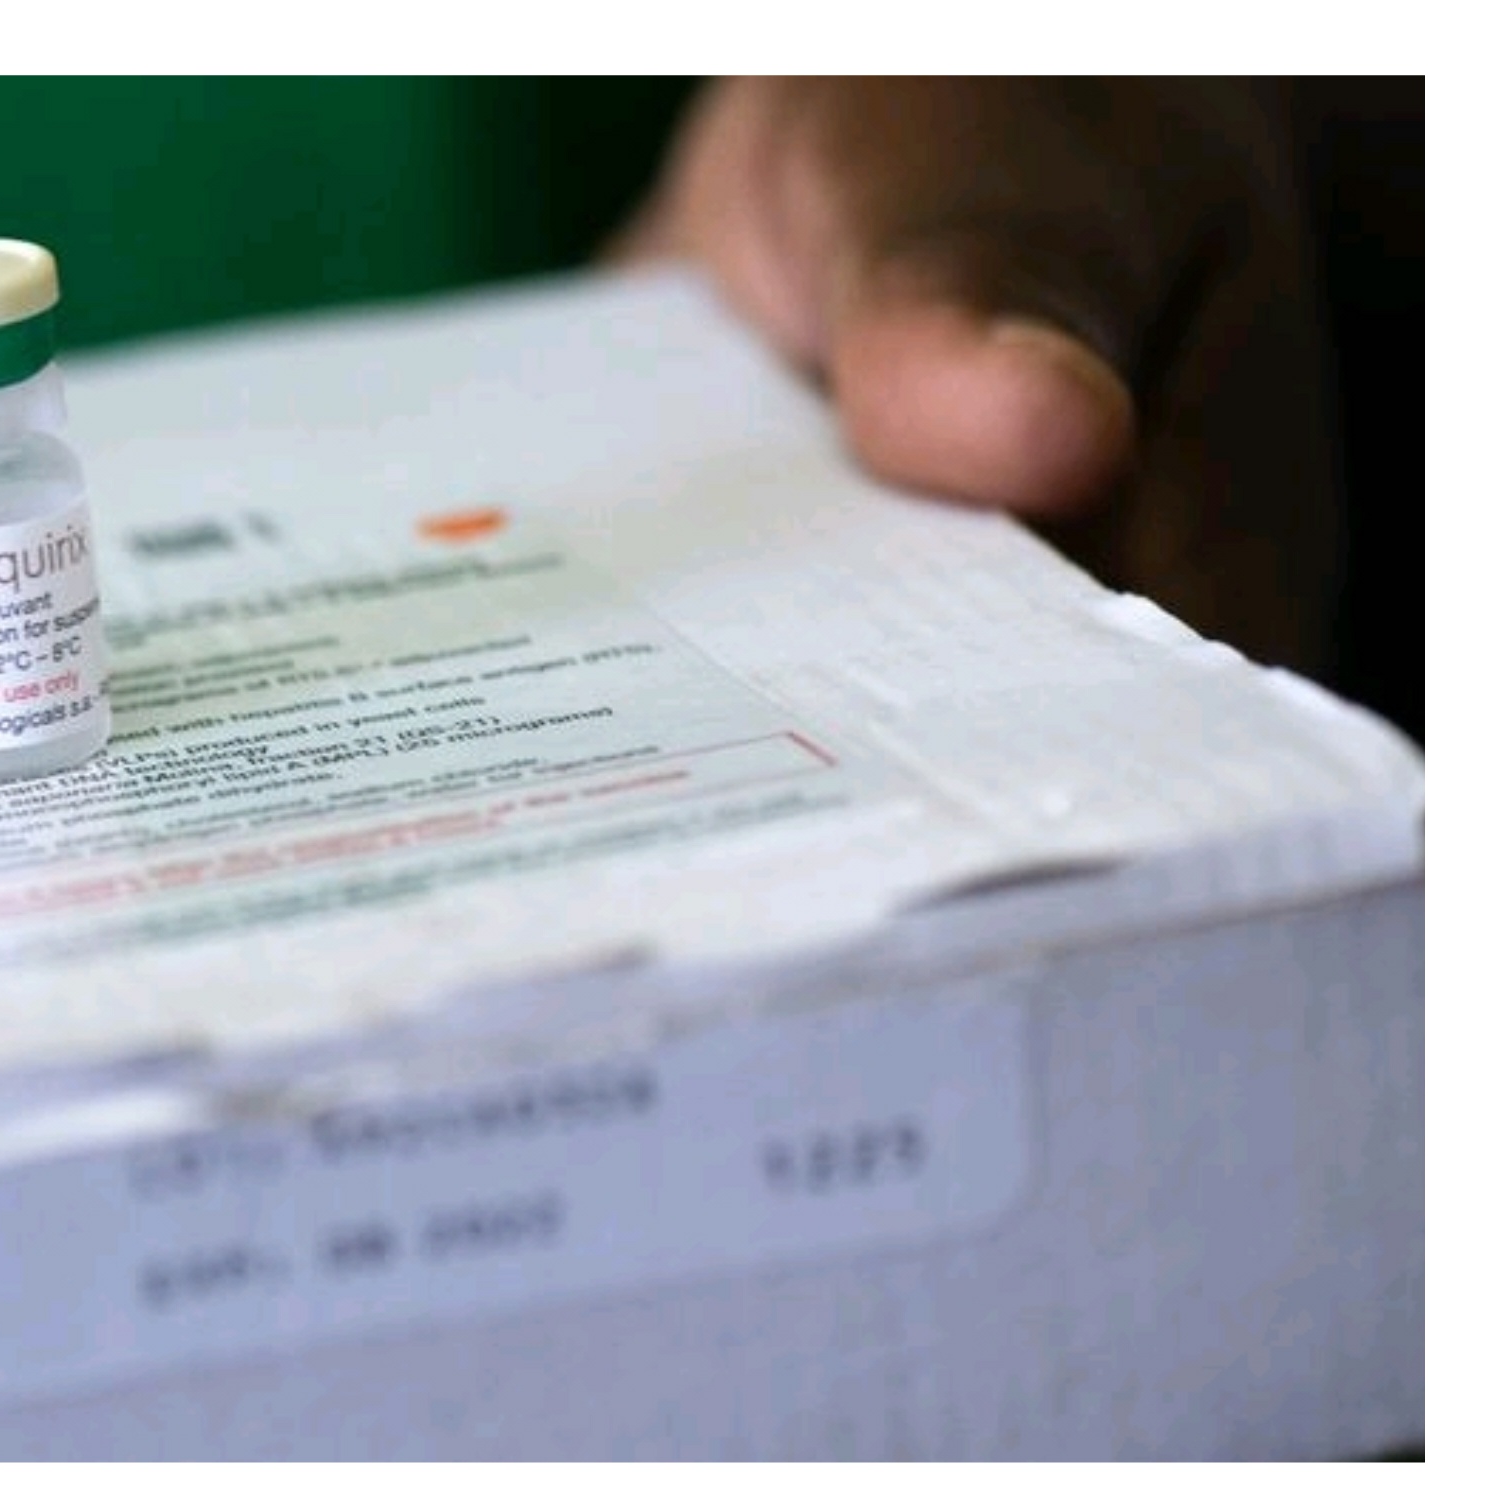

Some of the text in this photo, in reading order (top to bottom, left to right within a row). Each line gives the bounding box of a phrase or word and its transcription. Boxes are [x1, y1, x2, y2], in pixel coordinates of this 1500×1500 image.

[23, 617, 49, 638] for
[3, 682, 42, 704] use
[45, 669, 81, 696] only
